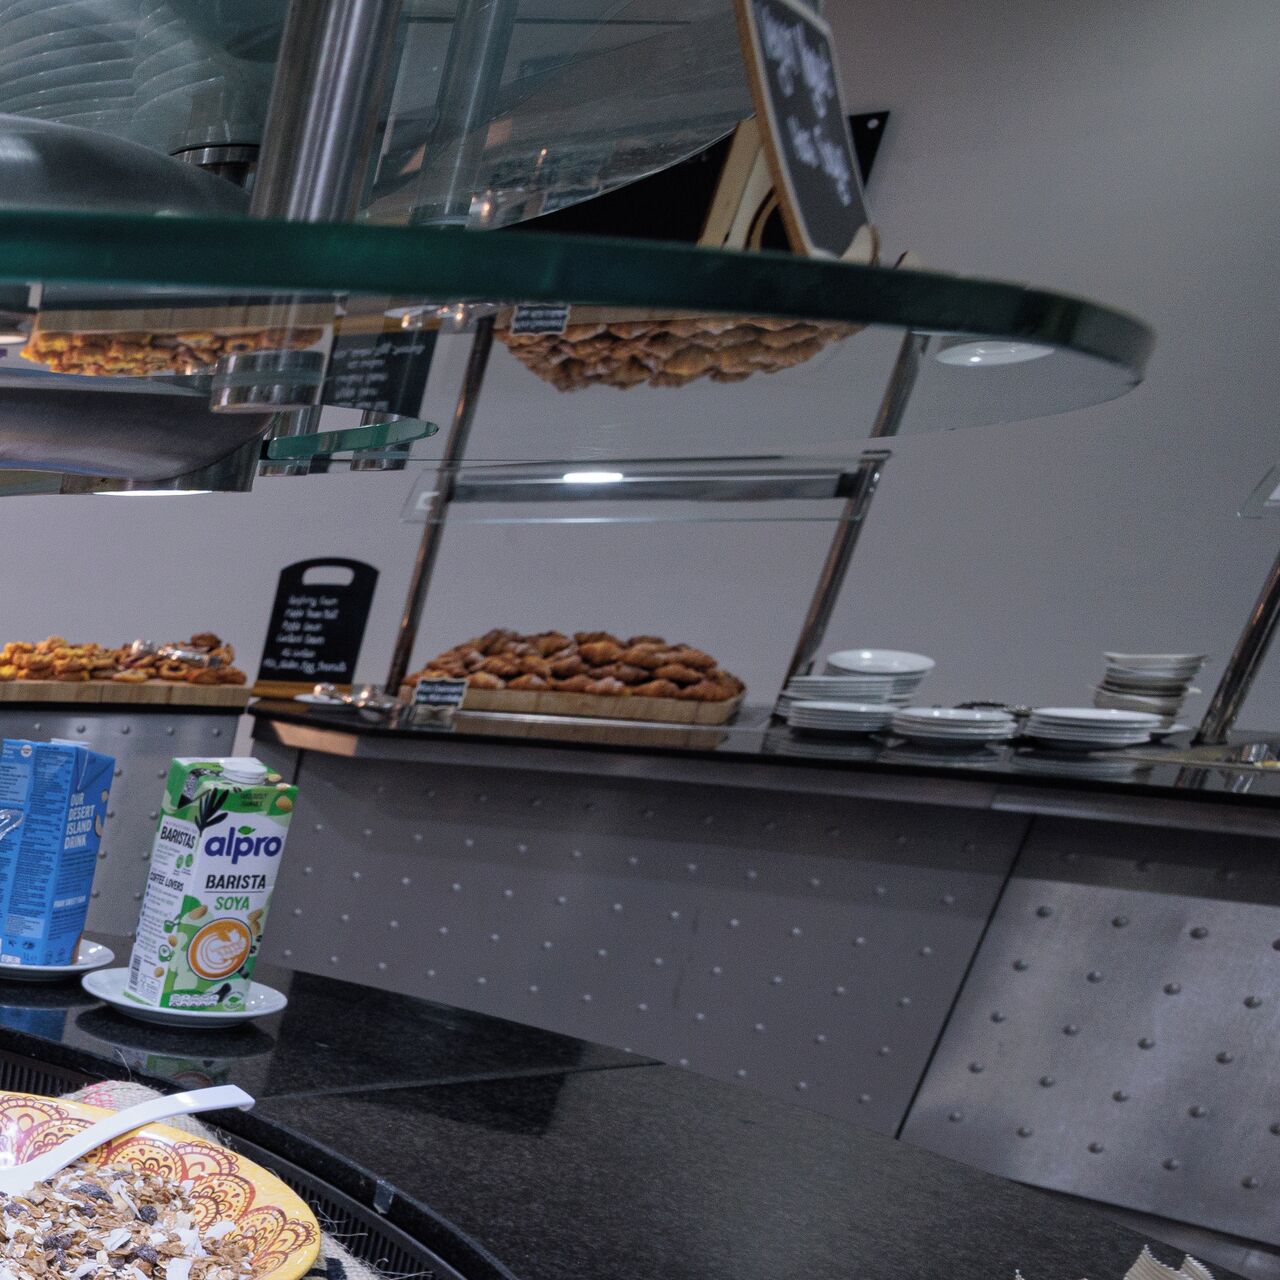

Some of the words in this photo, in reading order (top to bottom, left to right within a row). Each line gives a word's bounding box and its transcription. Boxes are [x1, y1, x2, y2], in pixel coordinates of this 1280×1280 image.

[70, 792, 85, 806] OUR
[68, 805, 95, 822] DESERT
[66, 819, 93, 836] ISLAND
[64, 836, 87, 850] DRINK
[160, 825, 196, 849] BARISTAS
[204, 827, 282, 864] alpro
[149, 871, 166, 885] COFFEE
[165, 877, 184, 892] LOVERS
[205, 874, 267, 890] BARISTA
[214, 896, 250, 910] SOYA
